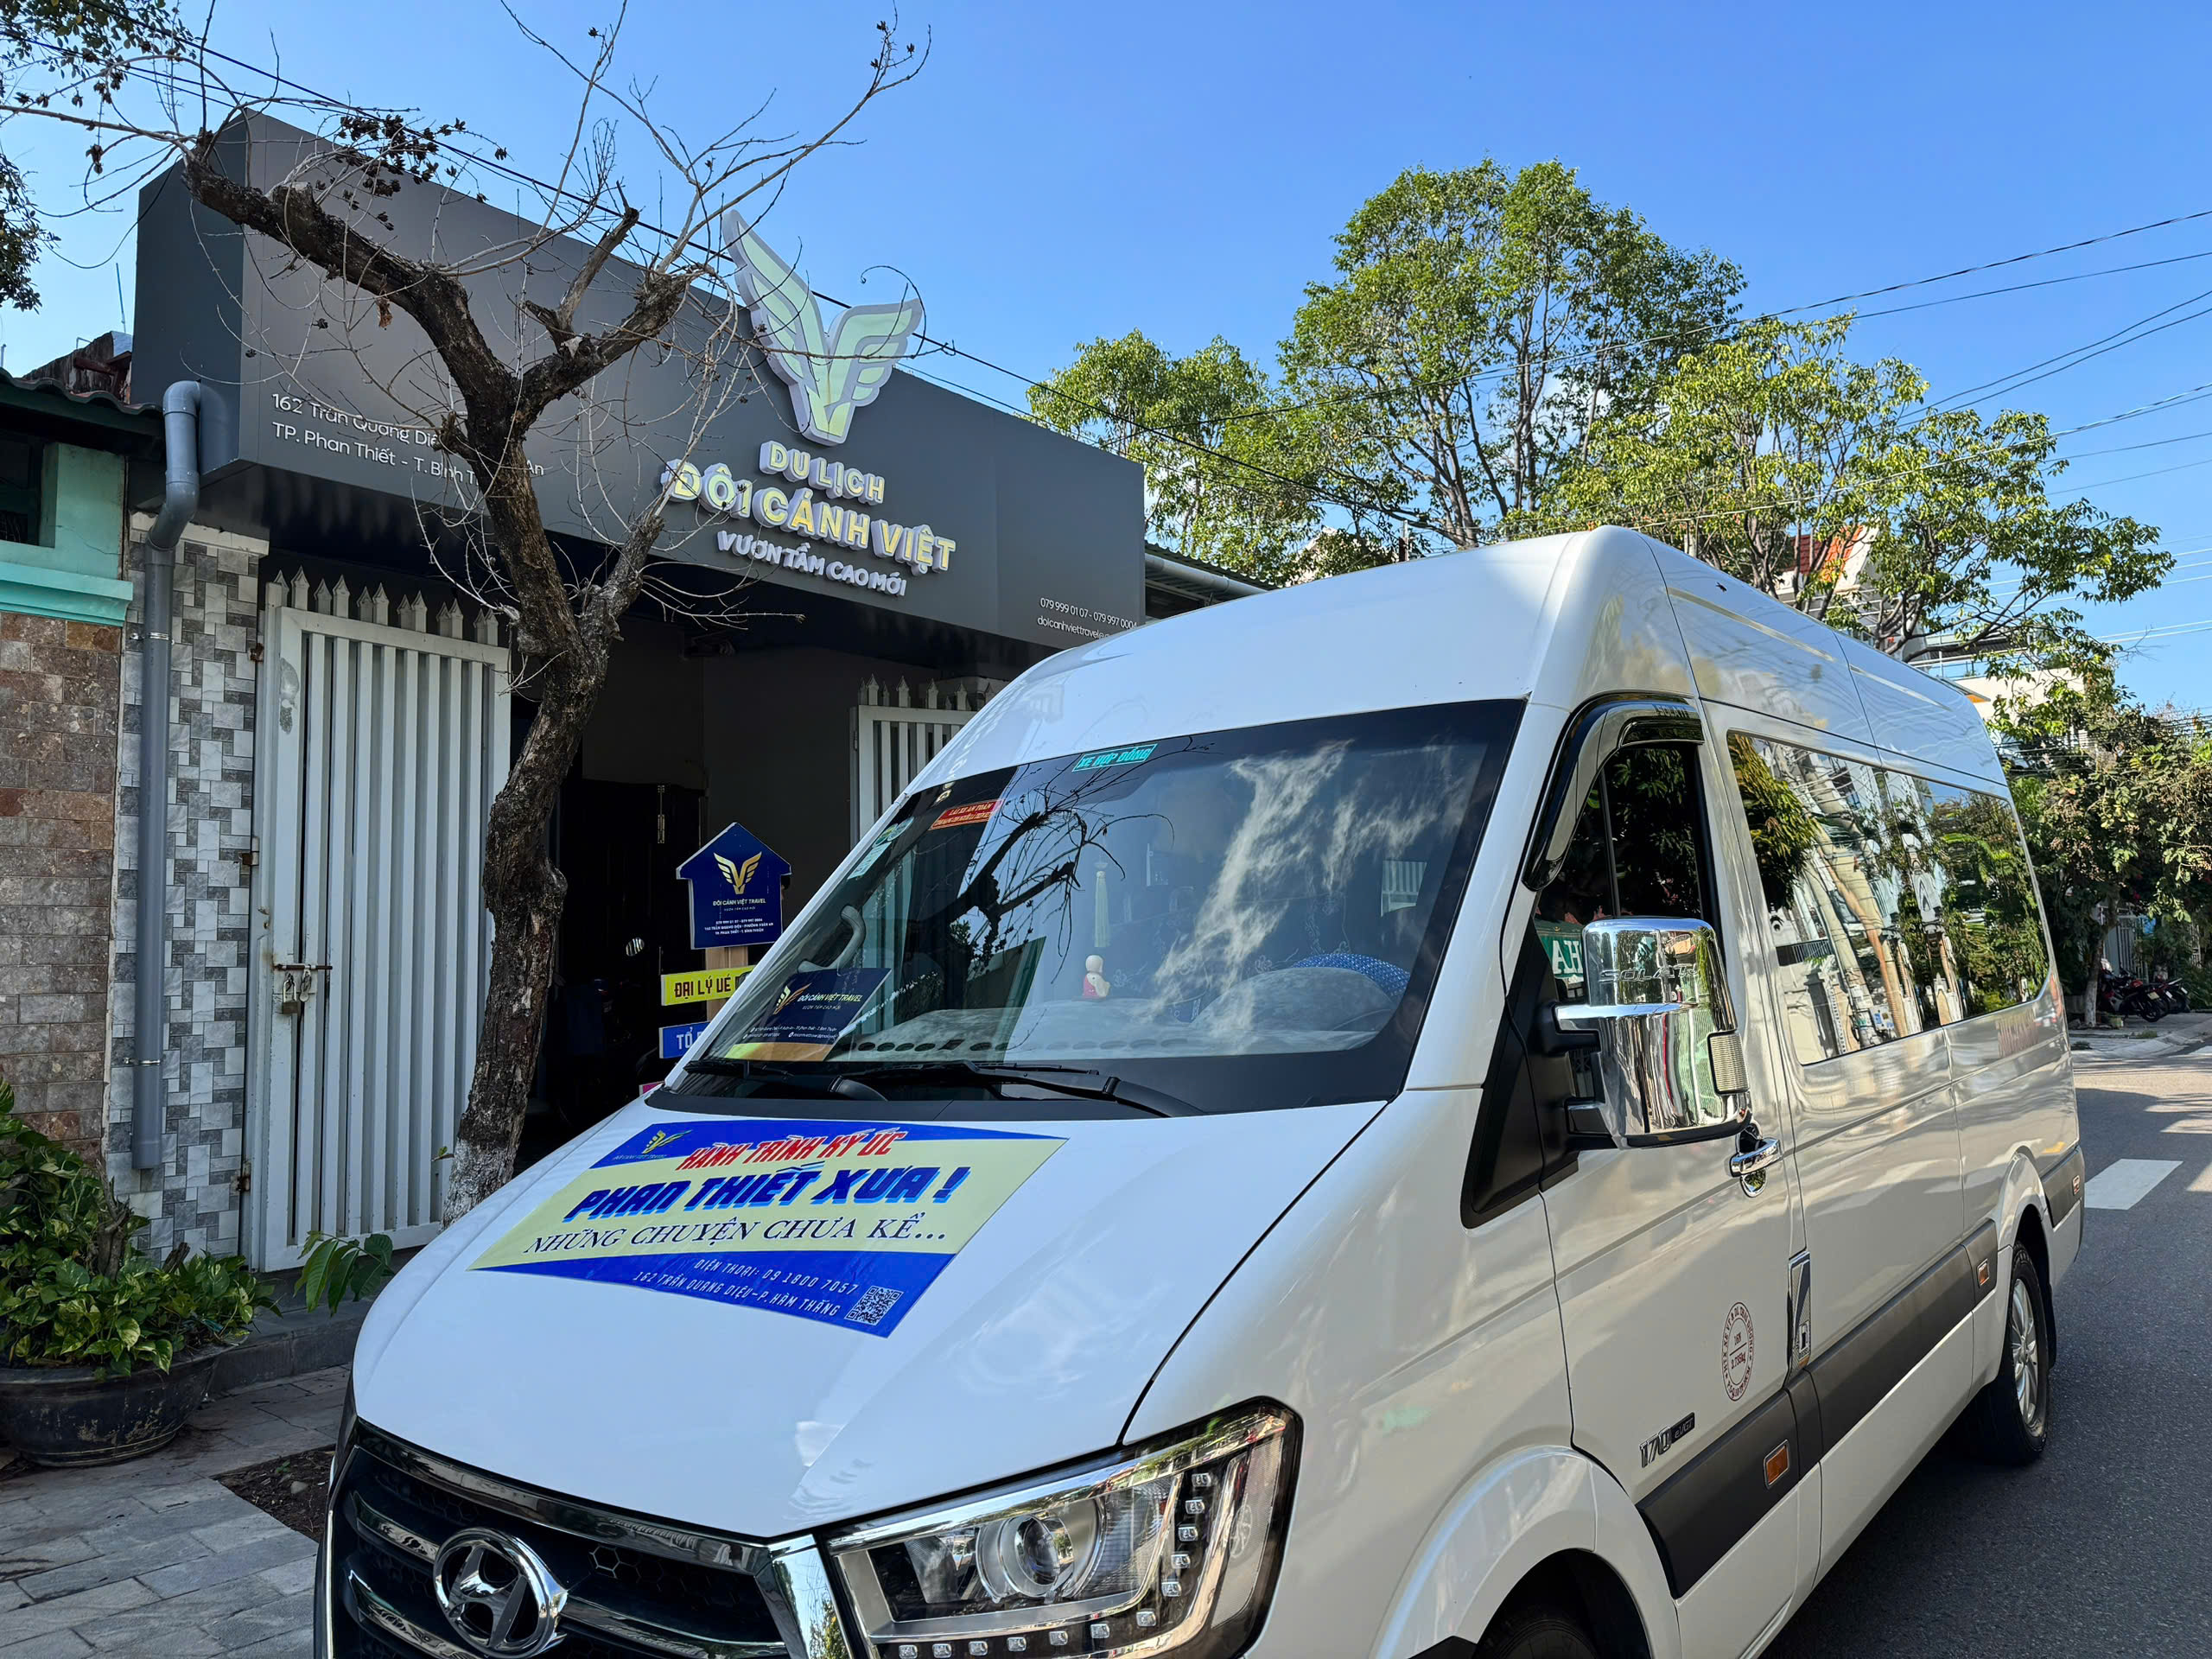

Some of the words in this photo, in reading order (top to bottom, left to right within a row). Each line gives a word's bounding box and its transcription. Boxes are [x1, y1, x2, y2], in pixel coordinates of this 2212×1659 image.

[271, 393, 302, 415] 162
[353, 416, 410, 444] Quang
[272, 422, 301, 442] TP.
[304, 430, 350, 454] Phan
[354, 442, 396, 466] Thiết
[413, 456, 428, 474] T.
[760, 440, 811, 482] DU
[808, 457, 885, 505] LỊCH
[661, 459, 753, 518] ĐÔI
[752, 487, 870, 550] CÁNH
[870, 519, 956, 576] VIỆT
[717, 531, 783, 564] VƯƠN
[825, 561, 869, 586] CAO
[868, 572, 906, 596] MỚI
[1040, 597, 1054, 609] 079
[1055, 601, 1070, 613] 999
[1093, 612, 1107, 623] 079
[1107, 615, 1120, 626] 997
[1077, 756, 1096, 768] XE
[1092, 753, 1118, 767] HỢP
[674, 981, 694, 999] ĐẠI
[697, 976, 713, 995] LÝ
[838, 994, 863, 1002] TRAVEL
[675, 1142, 753, 1171] HÀNH
[742, 1135, 828, 1164] TRÌNH
[817, 1128, 876, 1159] KÝ
[563, 1179, 691, 1222] PHAN
[683, 1160, 825, 1211] THIẾT
[810, 1165, 922, 1205] XƯA
[932, 1166, 971, 1204] !
[523, 1228, 626, 1254] NHỮNG
[630, 1216, 761, 1246] CHUYỆN
[763, 1216, 857, 1240] CHƯA
[632, 1271, 658, 1282] 162
[685, 1278, 722, 1294] QUANG
[820, 1279, 859, 1296] 7057
[1638, 1427, 1673, 1468] 170
